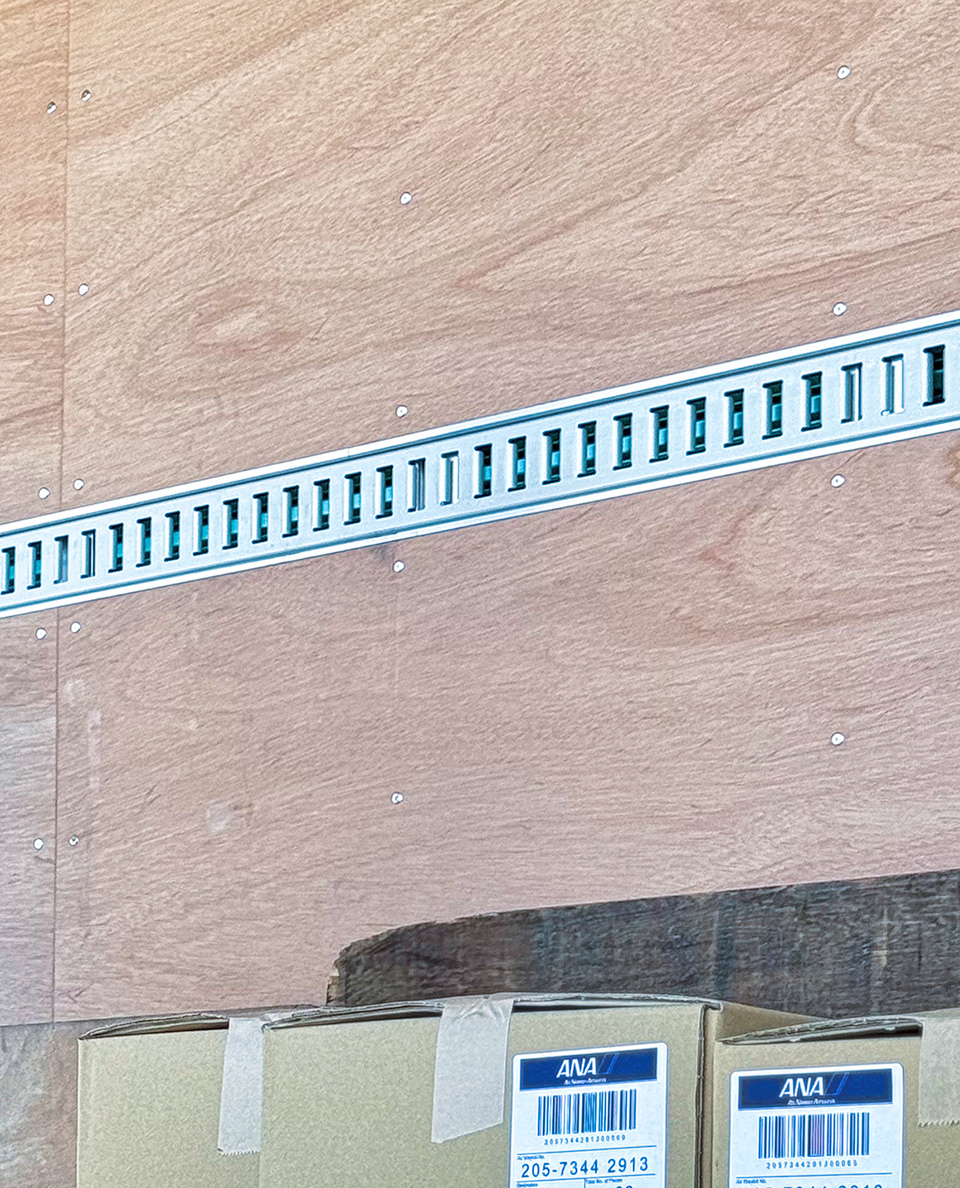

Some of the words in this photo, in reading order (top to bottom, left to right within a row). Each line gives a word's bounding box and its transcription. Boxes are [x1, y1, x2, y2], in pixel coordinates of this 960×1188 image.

[556, 1057, 597, 1079] ANA
[778, 1077, 824, 1098] ANA
[521, 1159, 599, 1178] 205-7344
[607, 1156, 649, 1174] 2913
